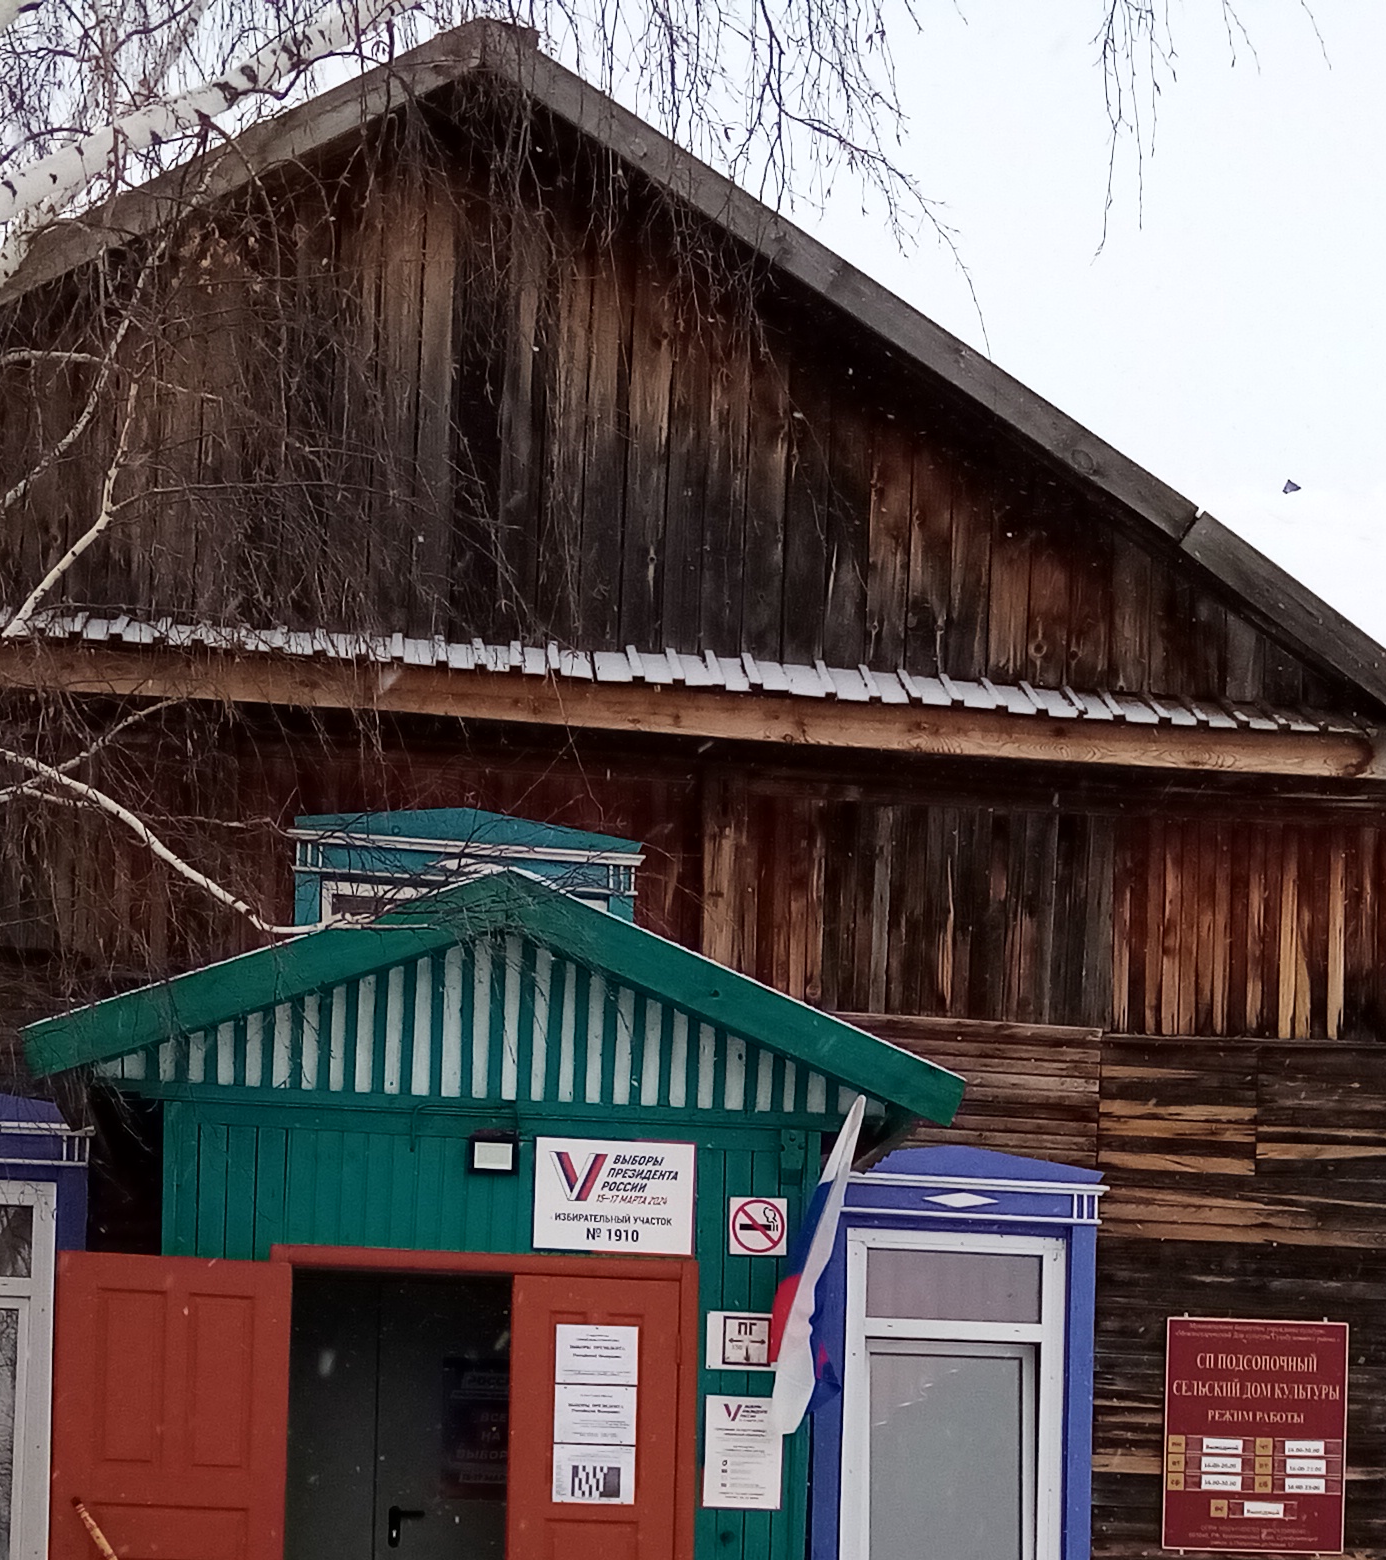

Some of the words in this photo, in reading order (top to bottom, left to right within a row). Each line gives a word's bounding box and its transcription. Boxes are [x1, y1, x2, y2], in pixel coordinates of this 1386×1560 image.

[613, 1154, 664, 1166] ВЫБОРЫ
[606, 1168, 679, 1181] ПРЕЗИДЕНТА
[601, 1181, 647, 1193] РОССИИ
[619, 1195, 647, 1205] МАРТА
[648, 1196, 668, 1206] 2024
[554, 1212, 631, 1224] ИЗБИРАТЕЛЬНЫЙ
[632, 1215, 672, 1226] УЧАСТОК
[586, 1227, 601, 1241] №
[607, 1228, 639, 1242] 1910
[738, 1321, 757, 1336] ПГ
[1196, 1352, 1214, 1369] СП
[1218, 1352, 1317, 1373] ПОДСОПОЧНЫЙ
[1172, 1378, 1240, 1397] СЕЛЬСКИЙ
[1242, 1381, 1271, 1399] ДОМ
[1274, 1383, 1340, 1400] КУЛЬТУРЫ
[1208, 1409, 1253, 1423] РЕЖИМ
[1256, 1411, 1304, 1424] РАБОТЫ
